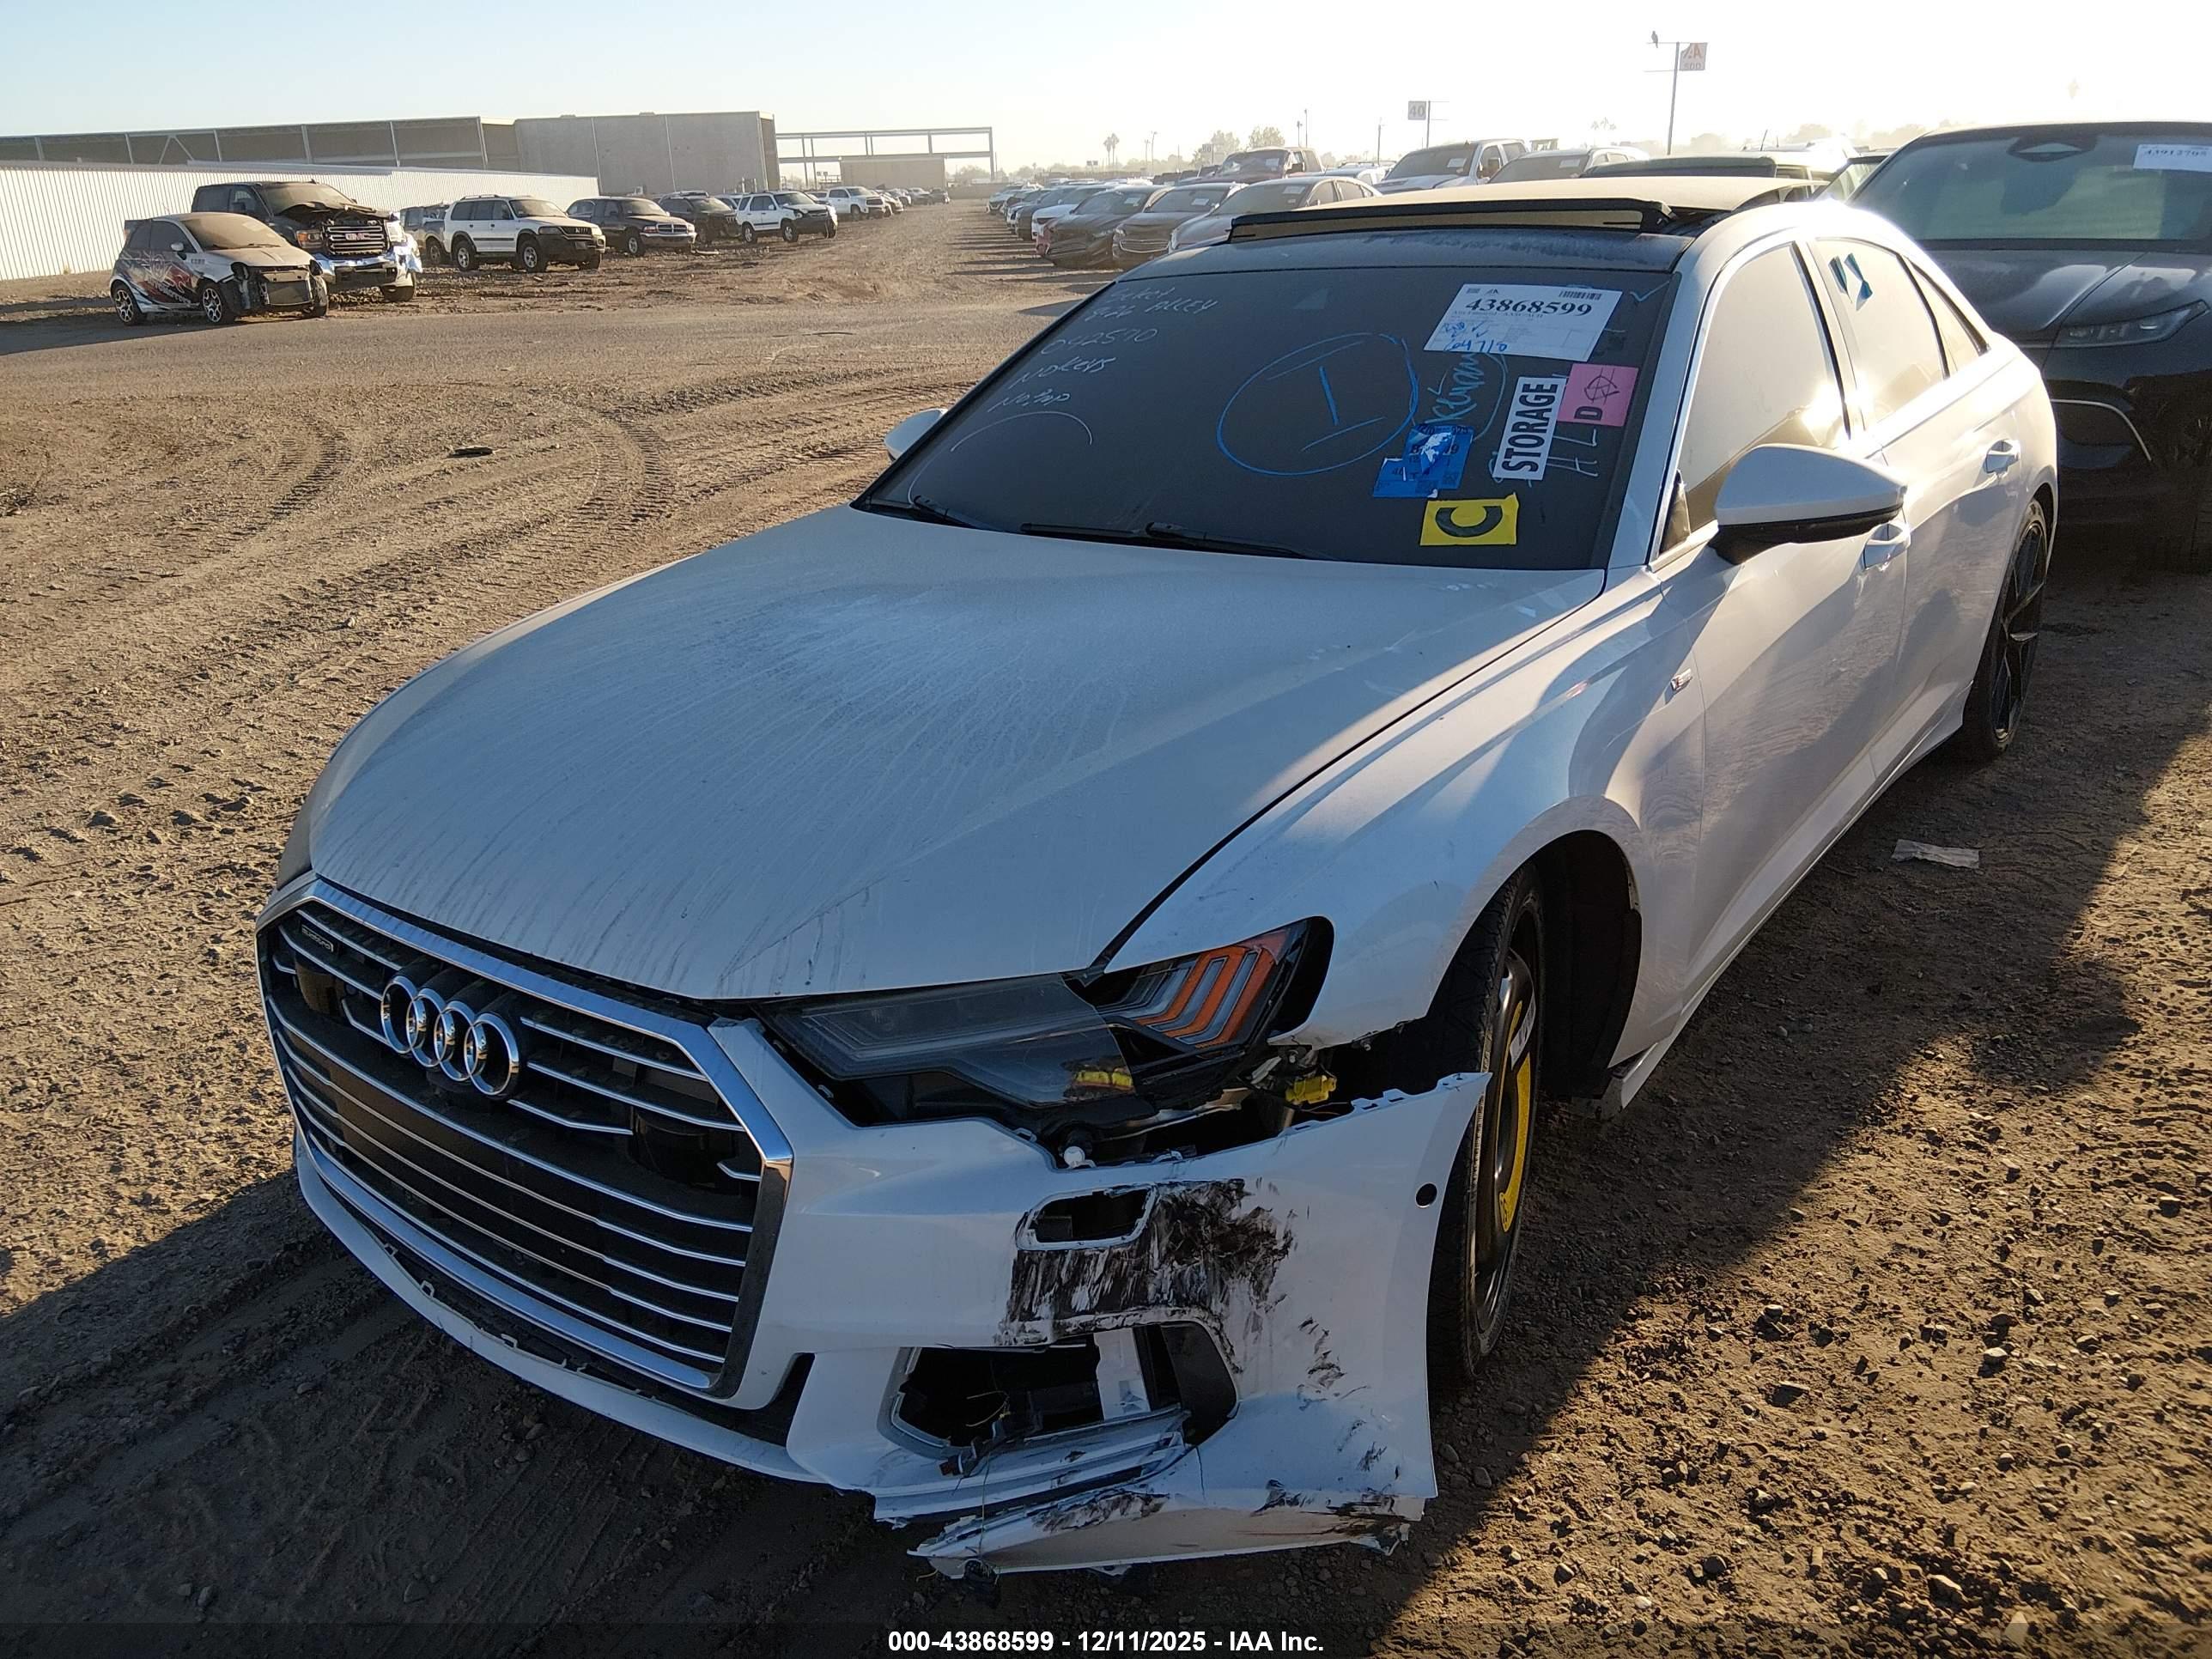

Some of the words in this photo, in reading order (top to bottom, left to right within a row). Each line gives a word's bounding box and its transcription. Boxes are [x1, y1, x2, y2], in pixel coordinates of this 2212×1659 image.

[1465, 297, 1593, 317] 43868599
[1573, 405, 1604, 422] D
[1501, 383, 1559, 473] STORAGE
[1435, 505, 1503, 538] C
